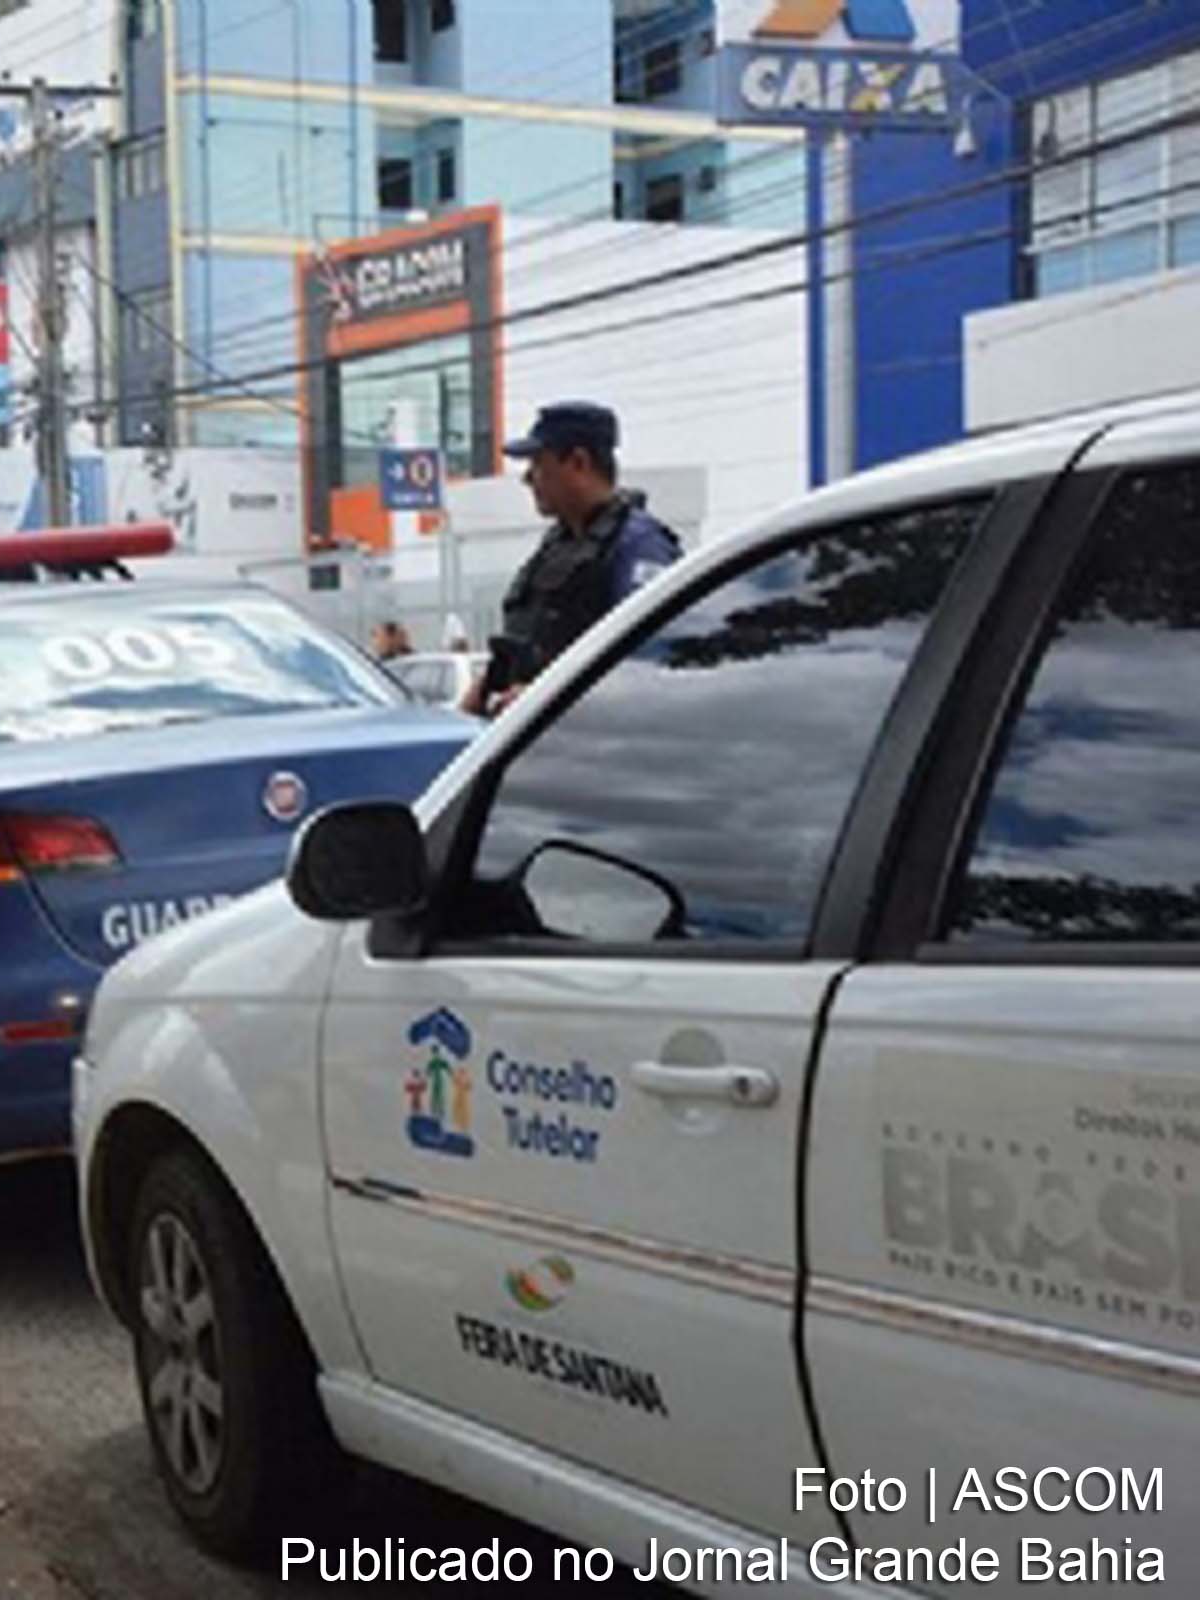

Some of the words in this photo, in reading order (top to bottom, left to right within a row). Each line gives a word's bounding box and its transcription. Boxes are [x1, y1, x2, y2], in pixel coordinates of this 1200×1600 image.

[741, 56, 948, 113] CAIXA
[43, 622, 236, 679] 005
[486, 1050, 617, 1111] Conselho
[501, 1106, 599, 1164] Tutelar
[456, 1314, 521, 1369] FEIRA
[518, 1331, 554, 1382] DE
[552, 1342, 671, 1420] SANTANA
